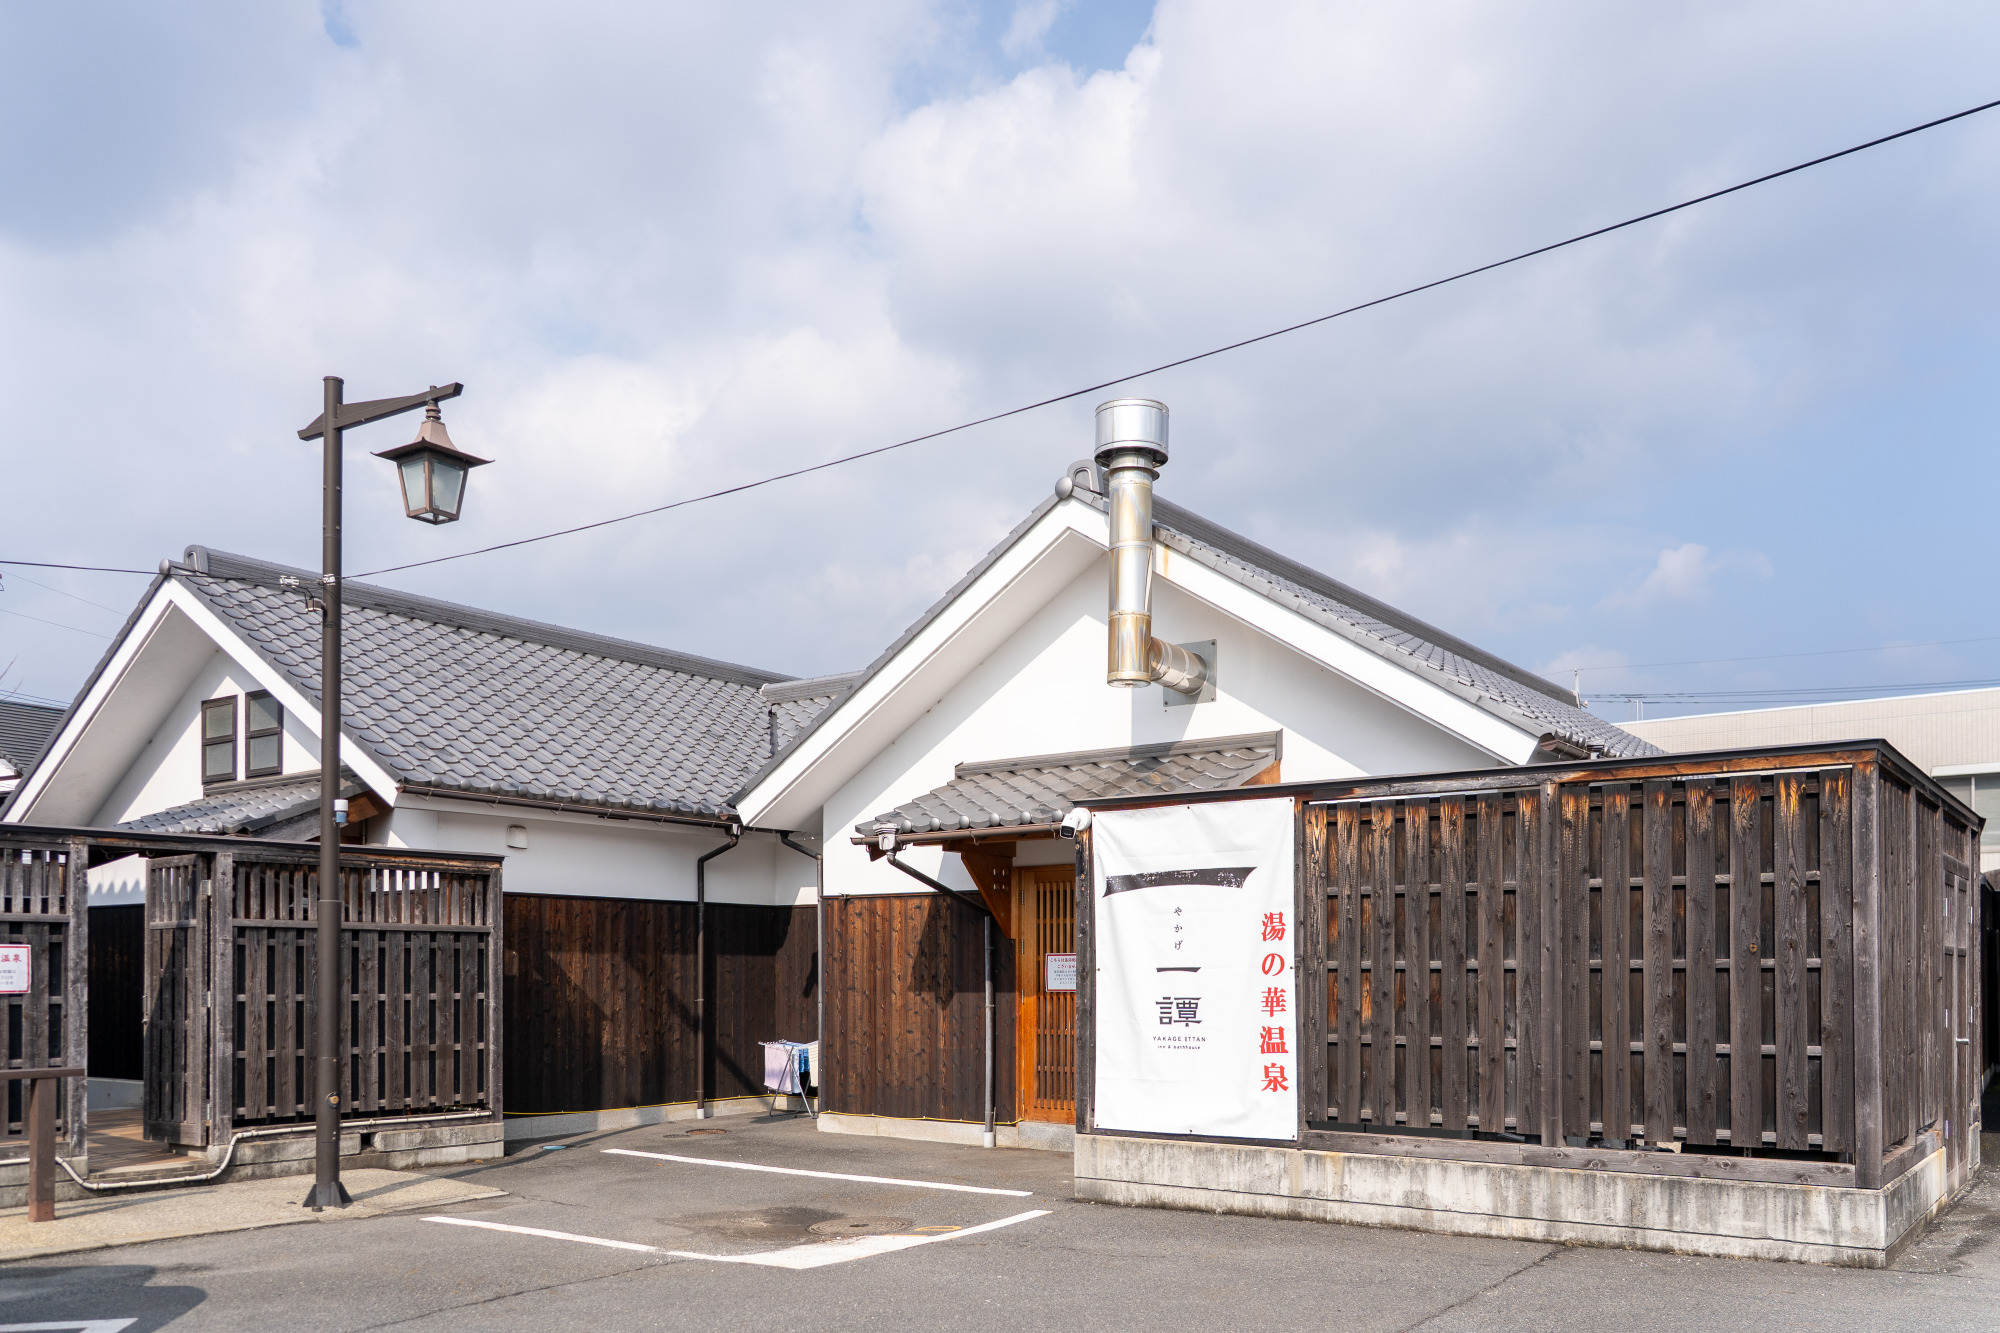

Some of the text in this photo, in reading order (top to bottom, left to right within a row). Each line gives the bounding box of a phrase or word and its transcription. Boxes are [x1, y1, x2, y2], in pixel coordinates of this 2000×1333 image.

[1173, 906, 1183, 950] やかげ
[1155, 966, 1203, 1028] 一譚
[1259, 911, 1289, 1093] 湯の華温泉
